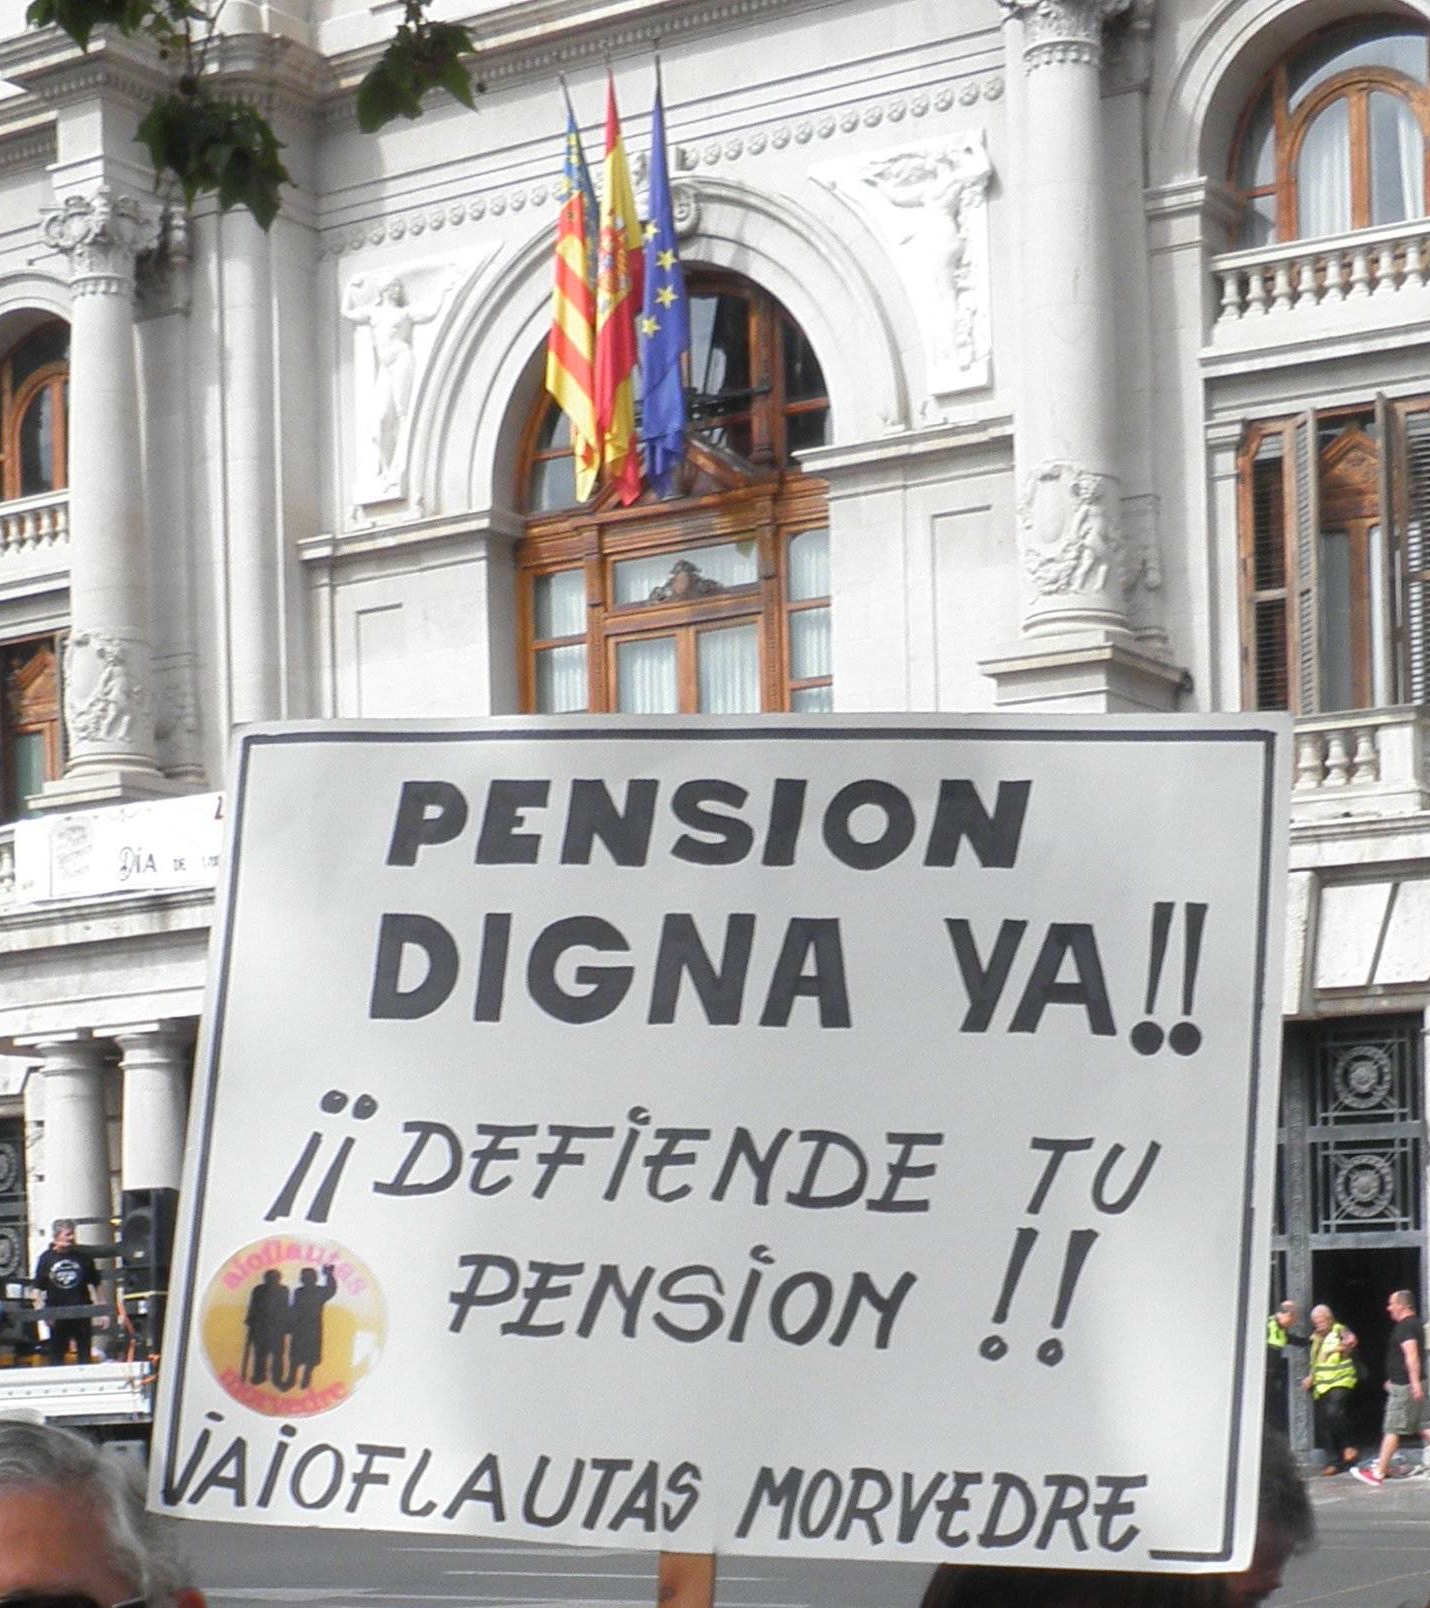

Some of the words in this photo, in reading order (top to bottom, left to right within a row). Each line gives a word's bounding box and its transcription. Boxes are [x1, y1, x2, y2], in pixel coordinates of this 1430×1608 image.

[387, 777, 1032, 871] PENSION
[370, 912, 852, 1029] DIGNA
[944, 901, 1208, 1056] YA!!
[1027, 1137, 1161, 1216] TU
[449, 1244, 917, 1350] PENSION
[735, 1466, 1149, 1554] MORVEDRE
